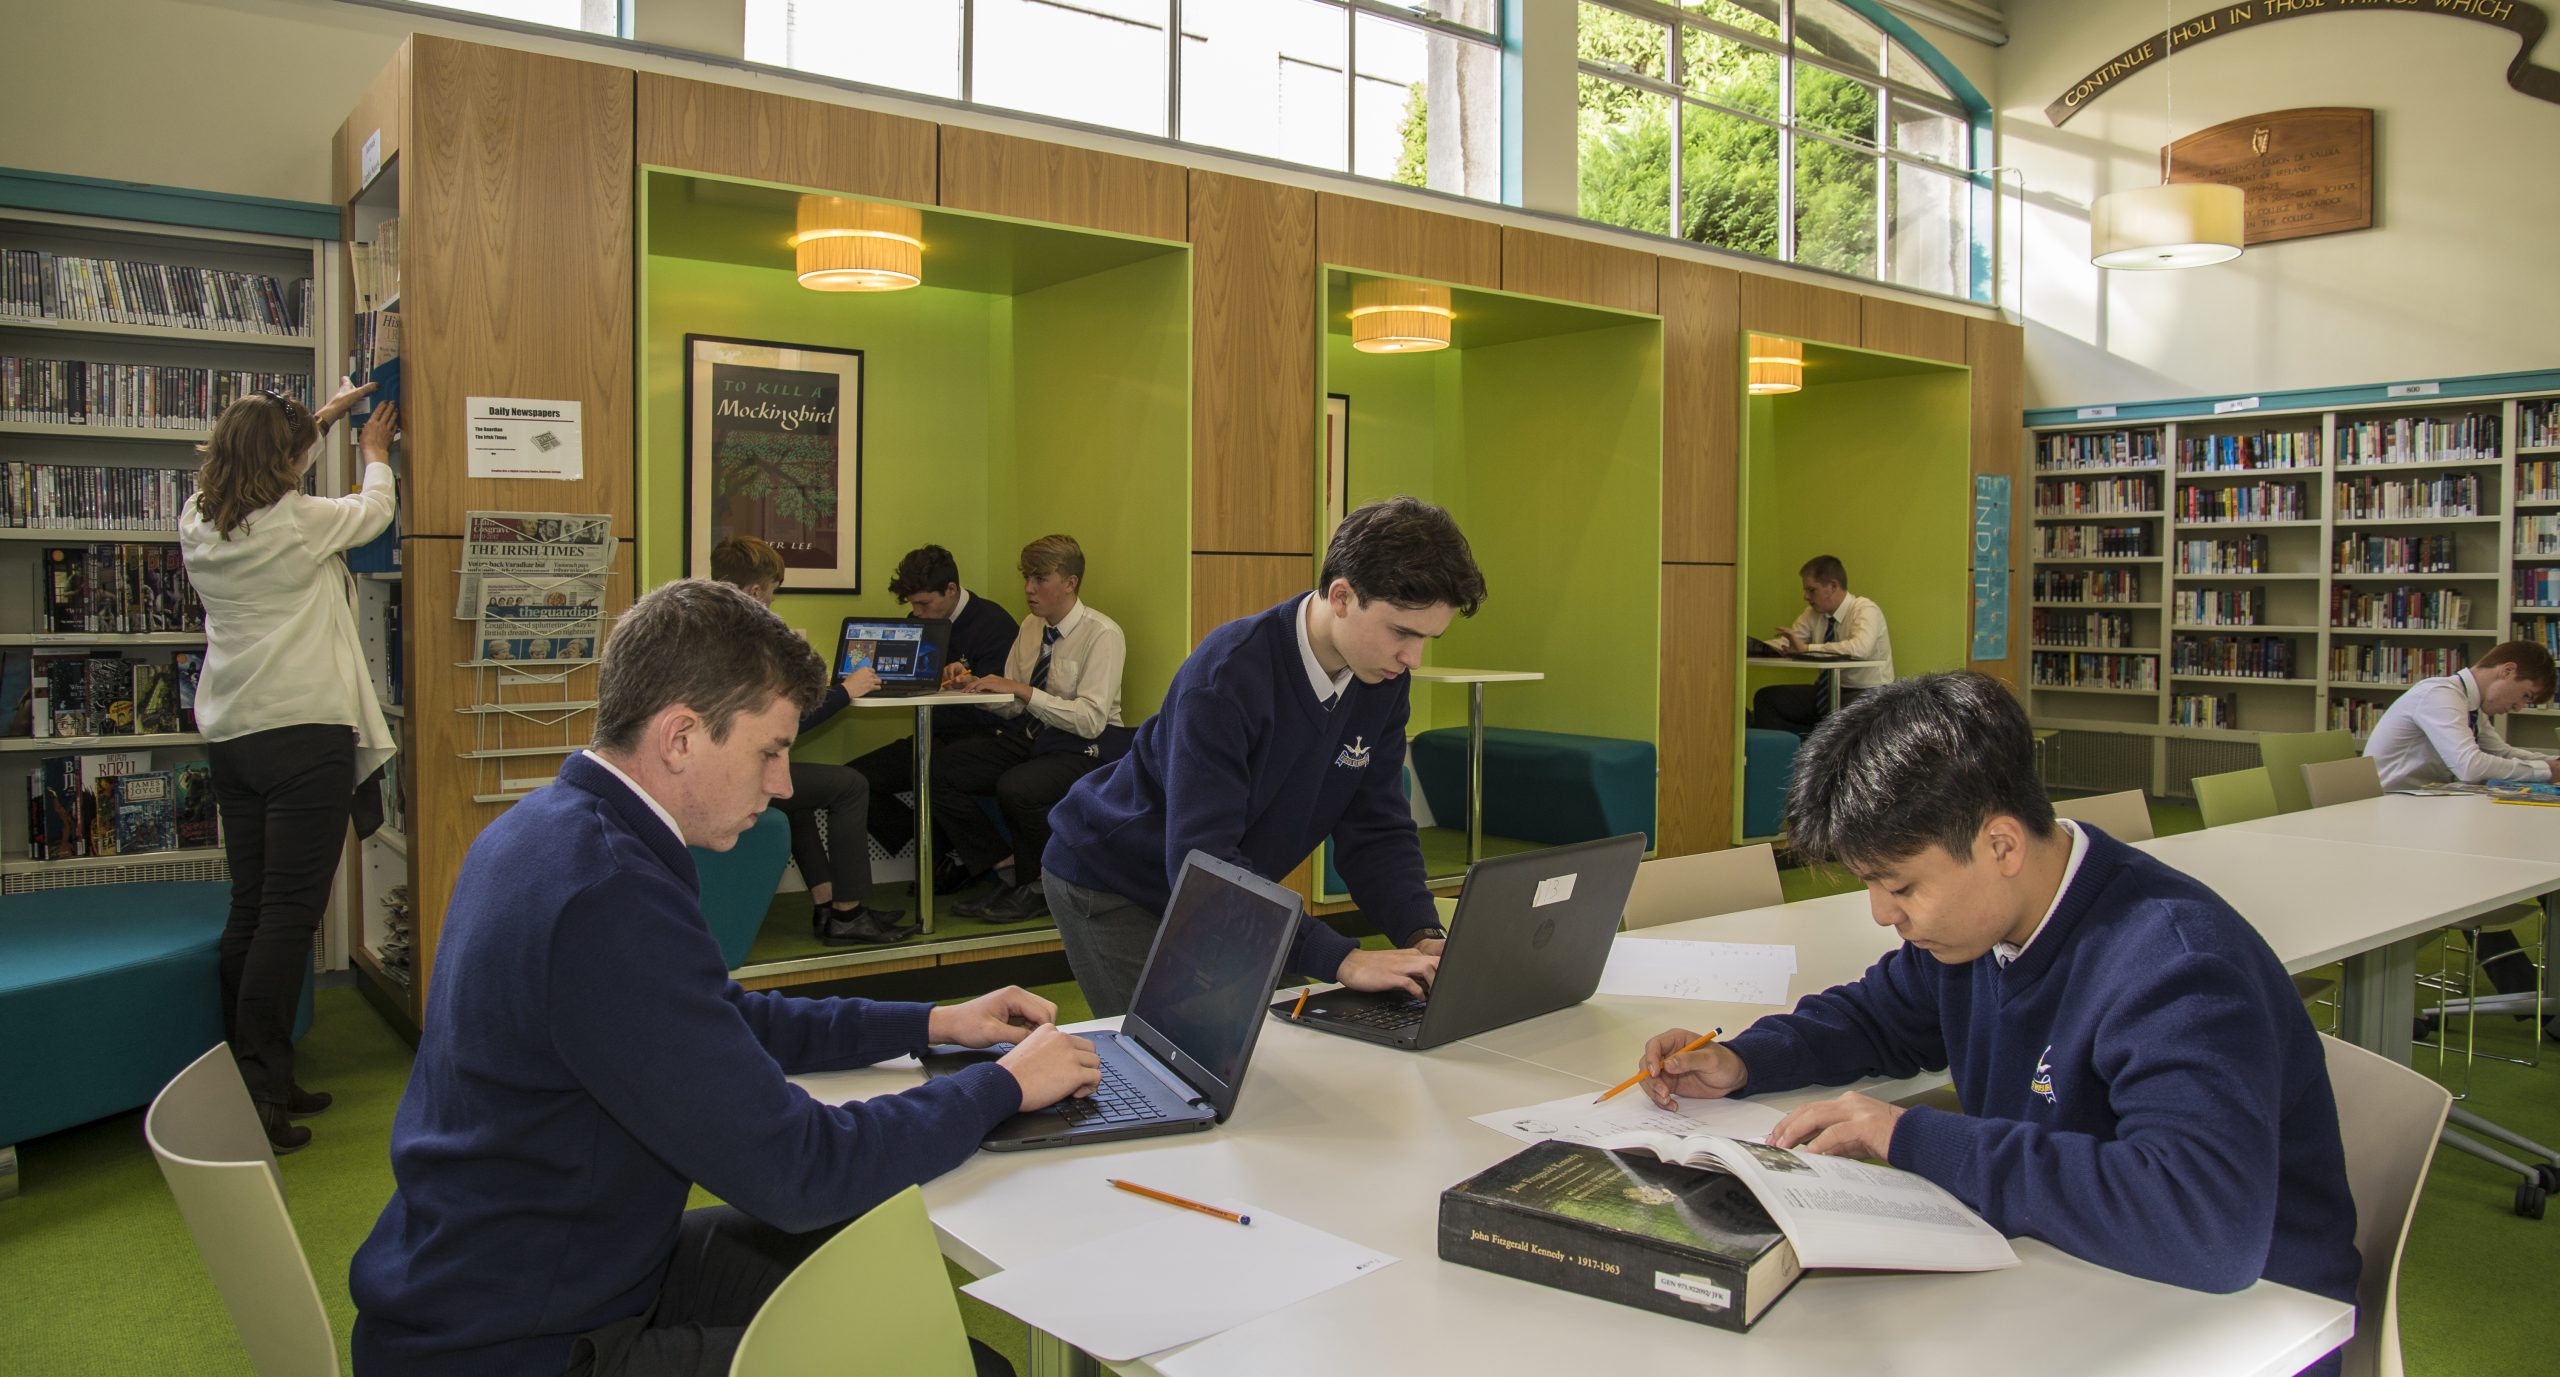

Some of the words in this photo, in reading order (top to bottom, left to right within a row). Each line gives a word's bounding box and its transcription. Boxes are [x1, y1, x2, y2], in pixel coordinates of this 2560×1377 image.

[2064, 43, 2154, 107] CONTINUE
[2161, 16, 2216, 49] THOU
[2230, 5, 2251, 25] IN
[724, 380, 746, 392] TO
[755, 382, 803, 397] KILL
[811, 386, 823, 398] A
[489, 406, 510, 417] Daily
[511, 407, 561, 418] Newspapers
[717, 398, 836, 431] Mockingbird
[1976, 476, 1992, 552] FIND
[473, 519, 496, 527] Lam
[470, 544, 499, 555] THE
[502, 545, 538, 556] IRISH
[542, 546, 585, 557] TIMES
[791, 541, 813, 550] LEE
[519, 606, 598, 618] theguardian
[485, 621, 517, 631] Coughing
[485, 629, 506, 637] British
[563, 628, 596, 636] nightmare
[130, 780, 160, 790] JAMES
[130, 787, 161, 797] JOYCE
[1471, 1229, 1489, 1241] John
[1491, 1234, 1529, 1251] Fitzgerald
[1531, 1244, 1565, 1262] Kennedy
[1577, 1256, 1621, 1275] 1917-1963
[1661, 1277, 1676, 1288] GEN
[1712, 1291, 1725, 1301] JFK
